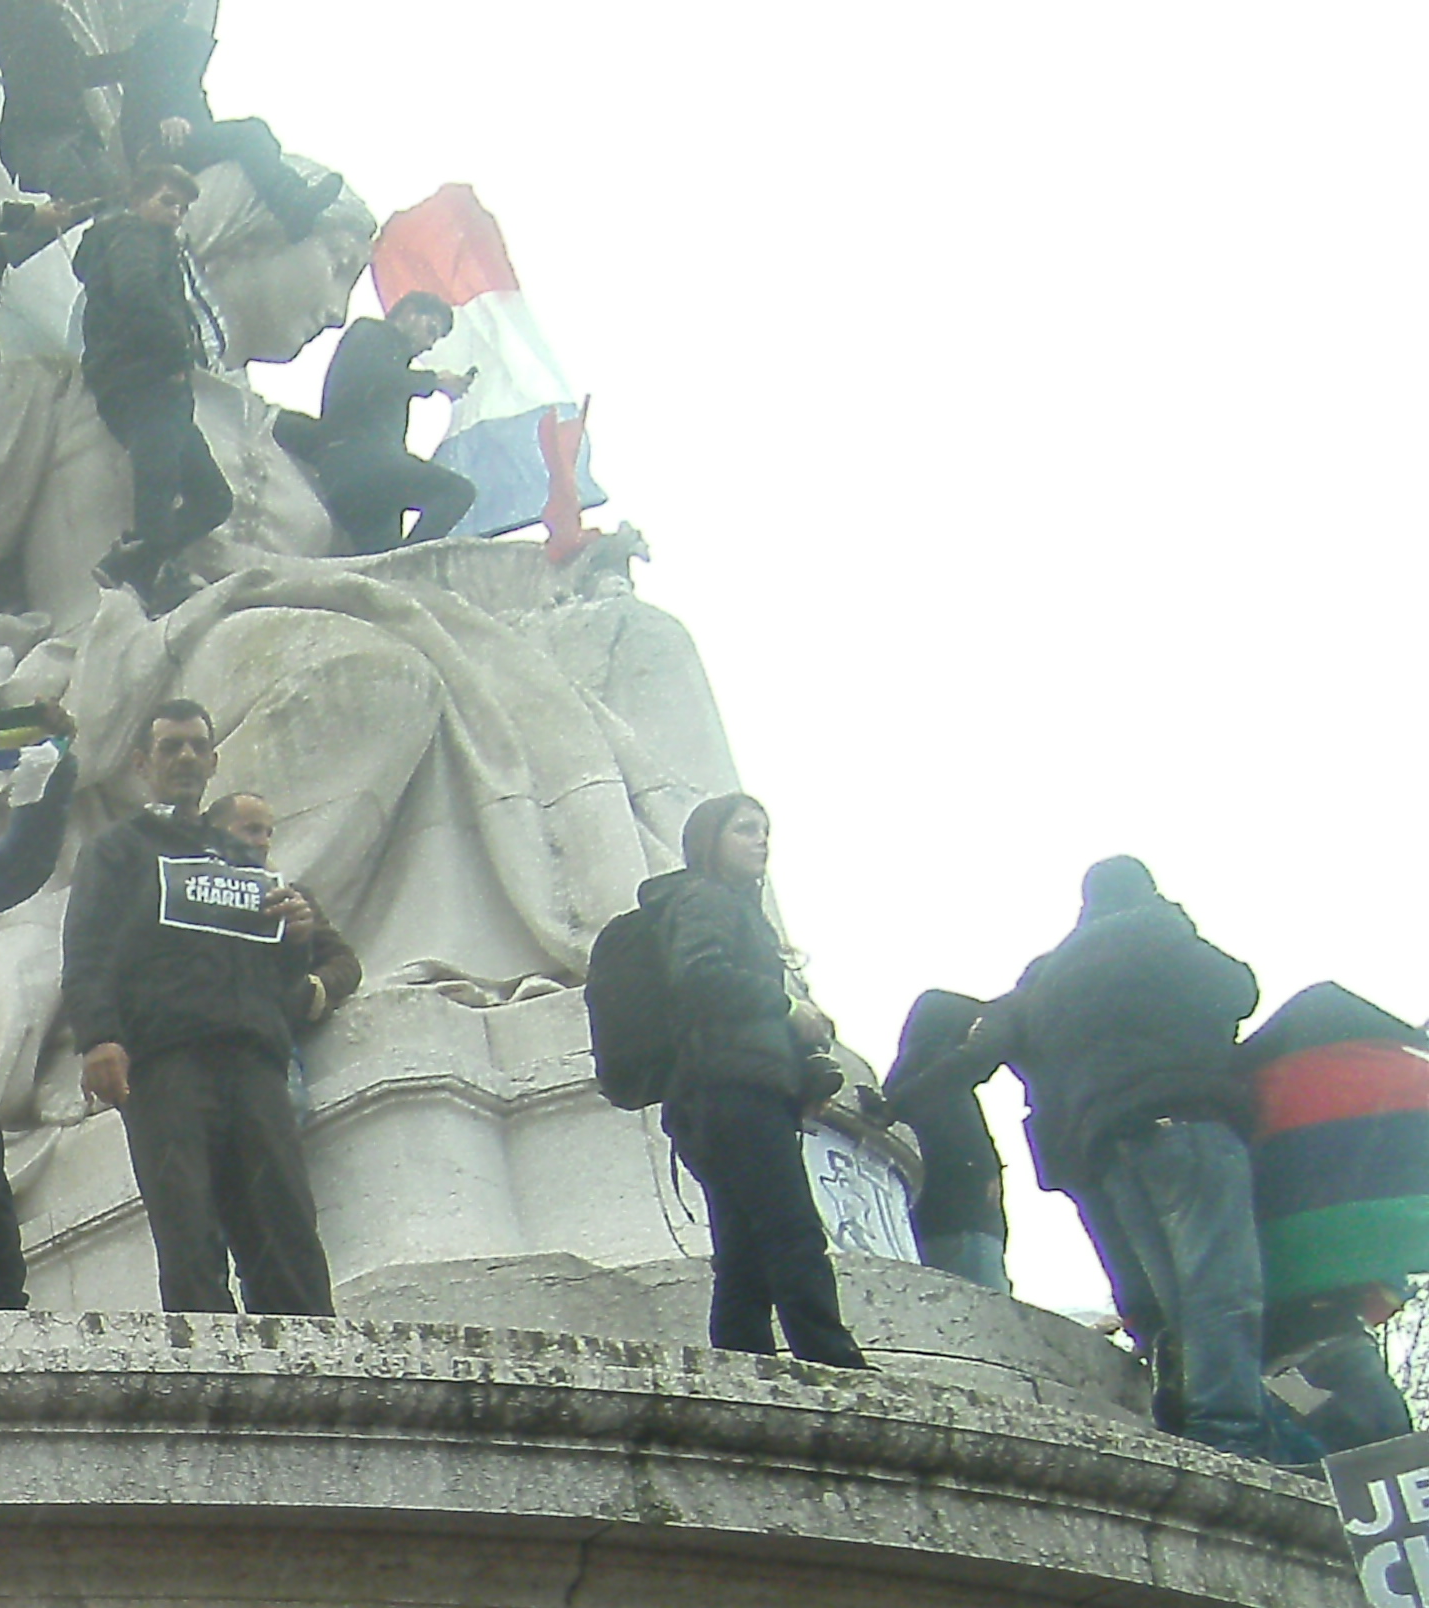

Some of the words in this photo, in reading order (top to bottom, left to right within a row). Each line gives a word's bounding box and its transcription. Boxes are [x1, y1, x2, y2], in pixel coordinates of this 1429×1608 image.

[185, 875, 211, 887] JE
[213, 877, 260, 893] SUIS
[185, 885, 261, 912] CHARLIE
